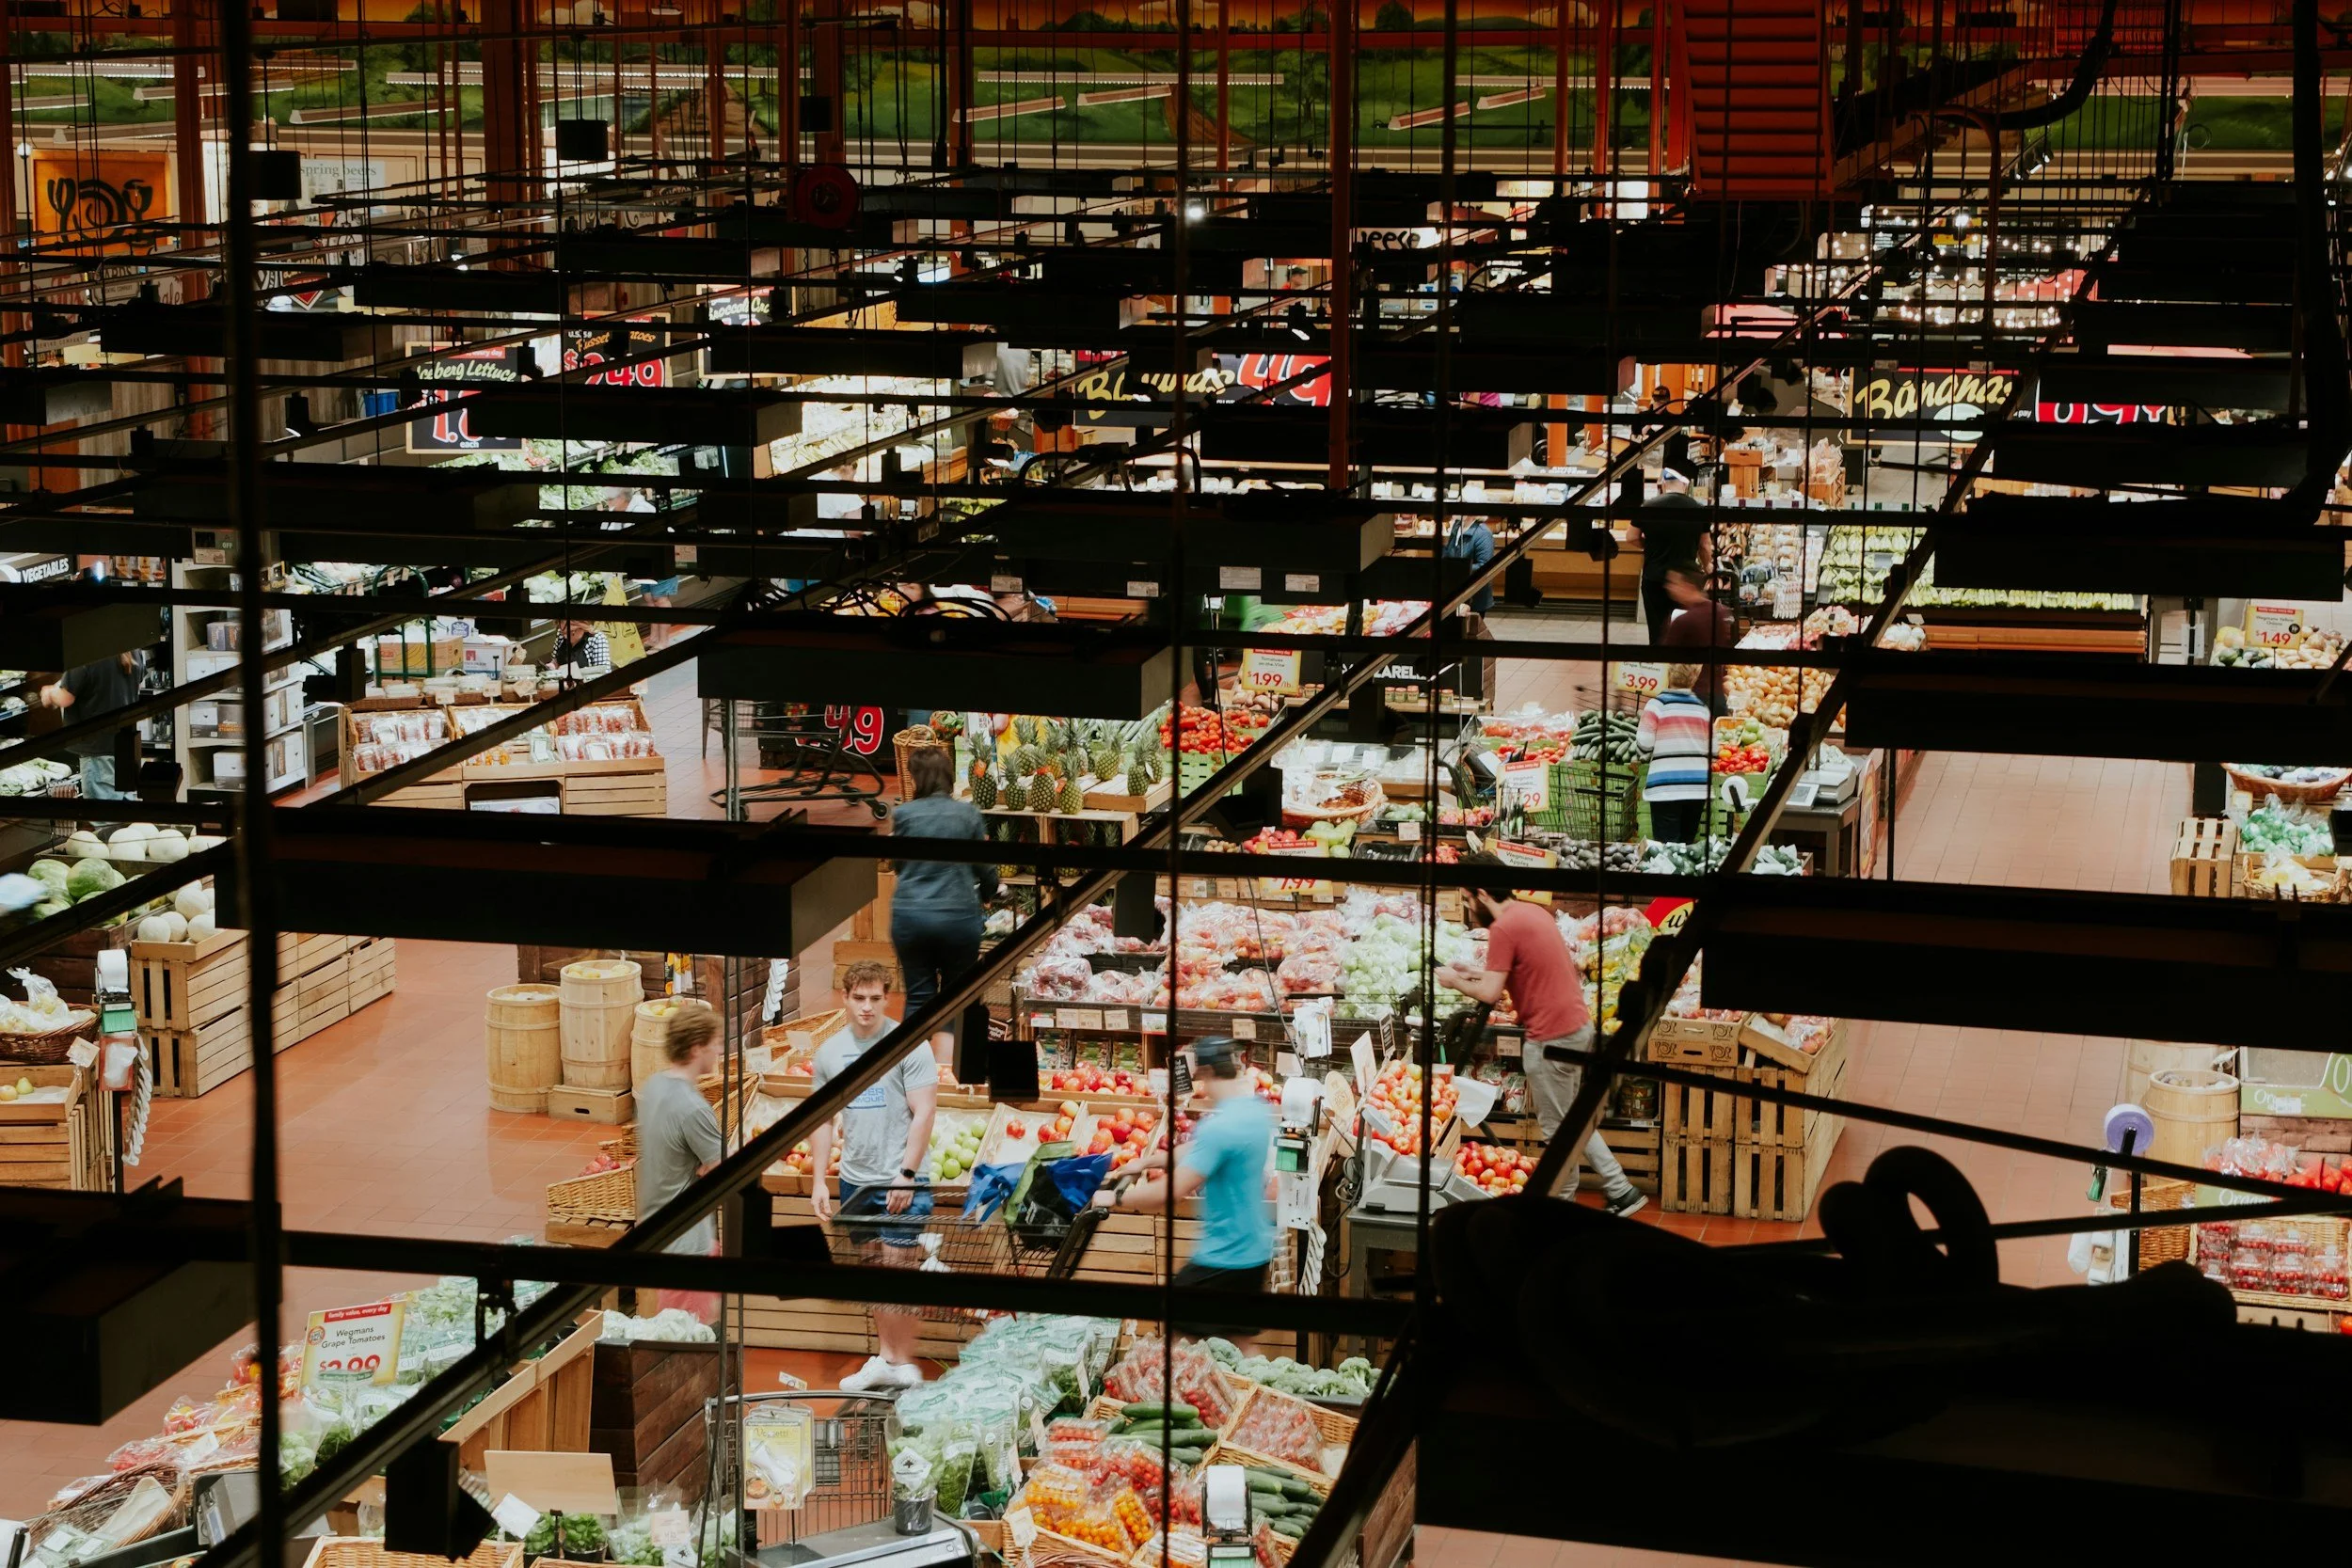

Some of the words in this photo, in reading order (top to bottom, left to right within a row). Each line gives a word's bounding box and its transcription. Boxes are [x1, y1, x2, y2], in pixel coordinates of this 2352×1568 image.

[301, 163, 340, 177] spring
[467, 359, 516, 383] Lettuce
[459, 440, 480, 449] each
[22, 557, 70, 584] VEGETABLES
[2256, 630, 2292, 645] $1.49
[1622, 672, 1658, 691] $3.99
[361, 1307, 377, 1315] every
[377, 1305, 389, 1313] day
[336, 1327, 374, 1338] Wegmans
[321, 1339, 346, 1349] Grape
[348, 1334, 386, 1345] Tomatoes
